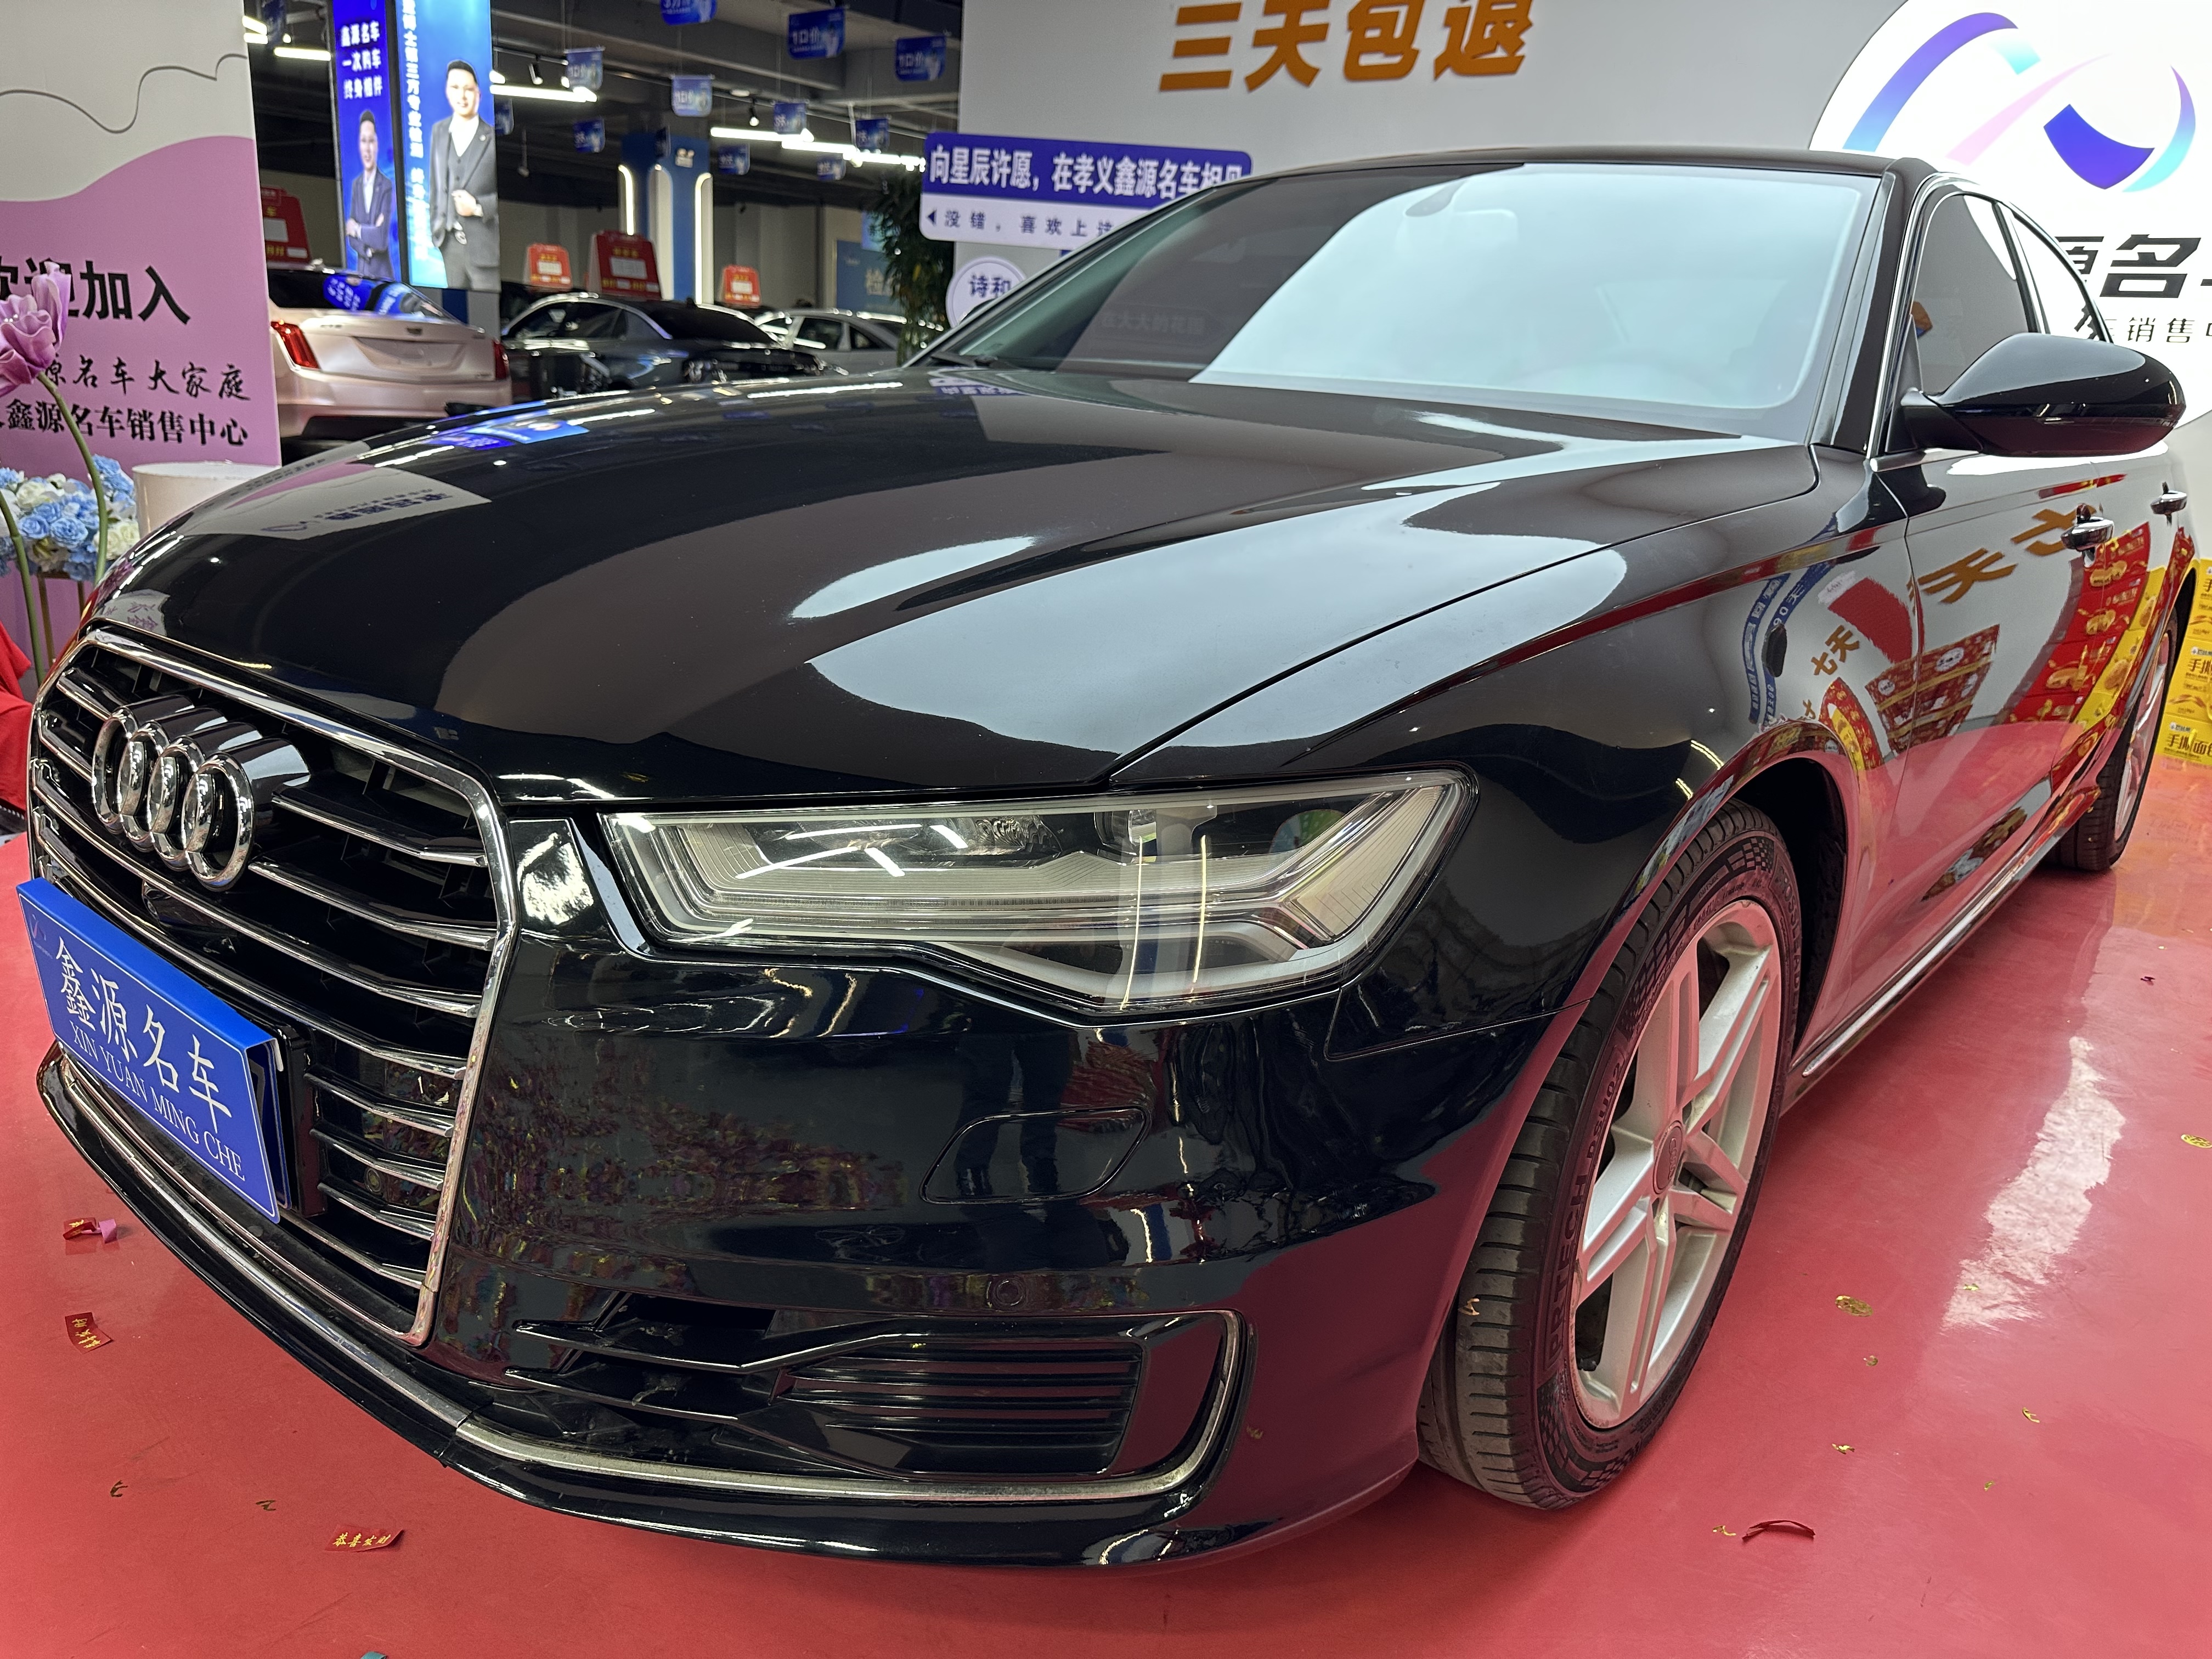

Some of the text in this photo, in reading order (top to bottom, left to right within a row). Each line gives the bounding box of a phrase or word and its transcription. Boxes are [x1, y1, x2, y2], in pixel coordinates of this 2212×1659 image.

[1159, 0, 1533, 93] 三天包退
[969, 274, 1011, 298] 诗和
[0, 398, 249, 446] 鑫源名车销售中心
[56, 936, 232, 1133] 鑫源名车
[69, 1020, 246, 1182] XIN YUAN MING CHE
